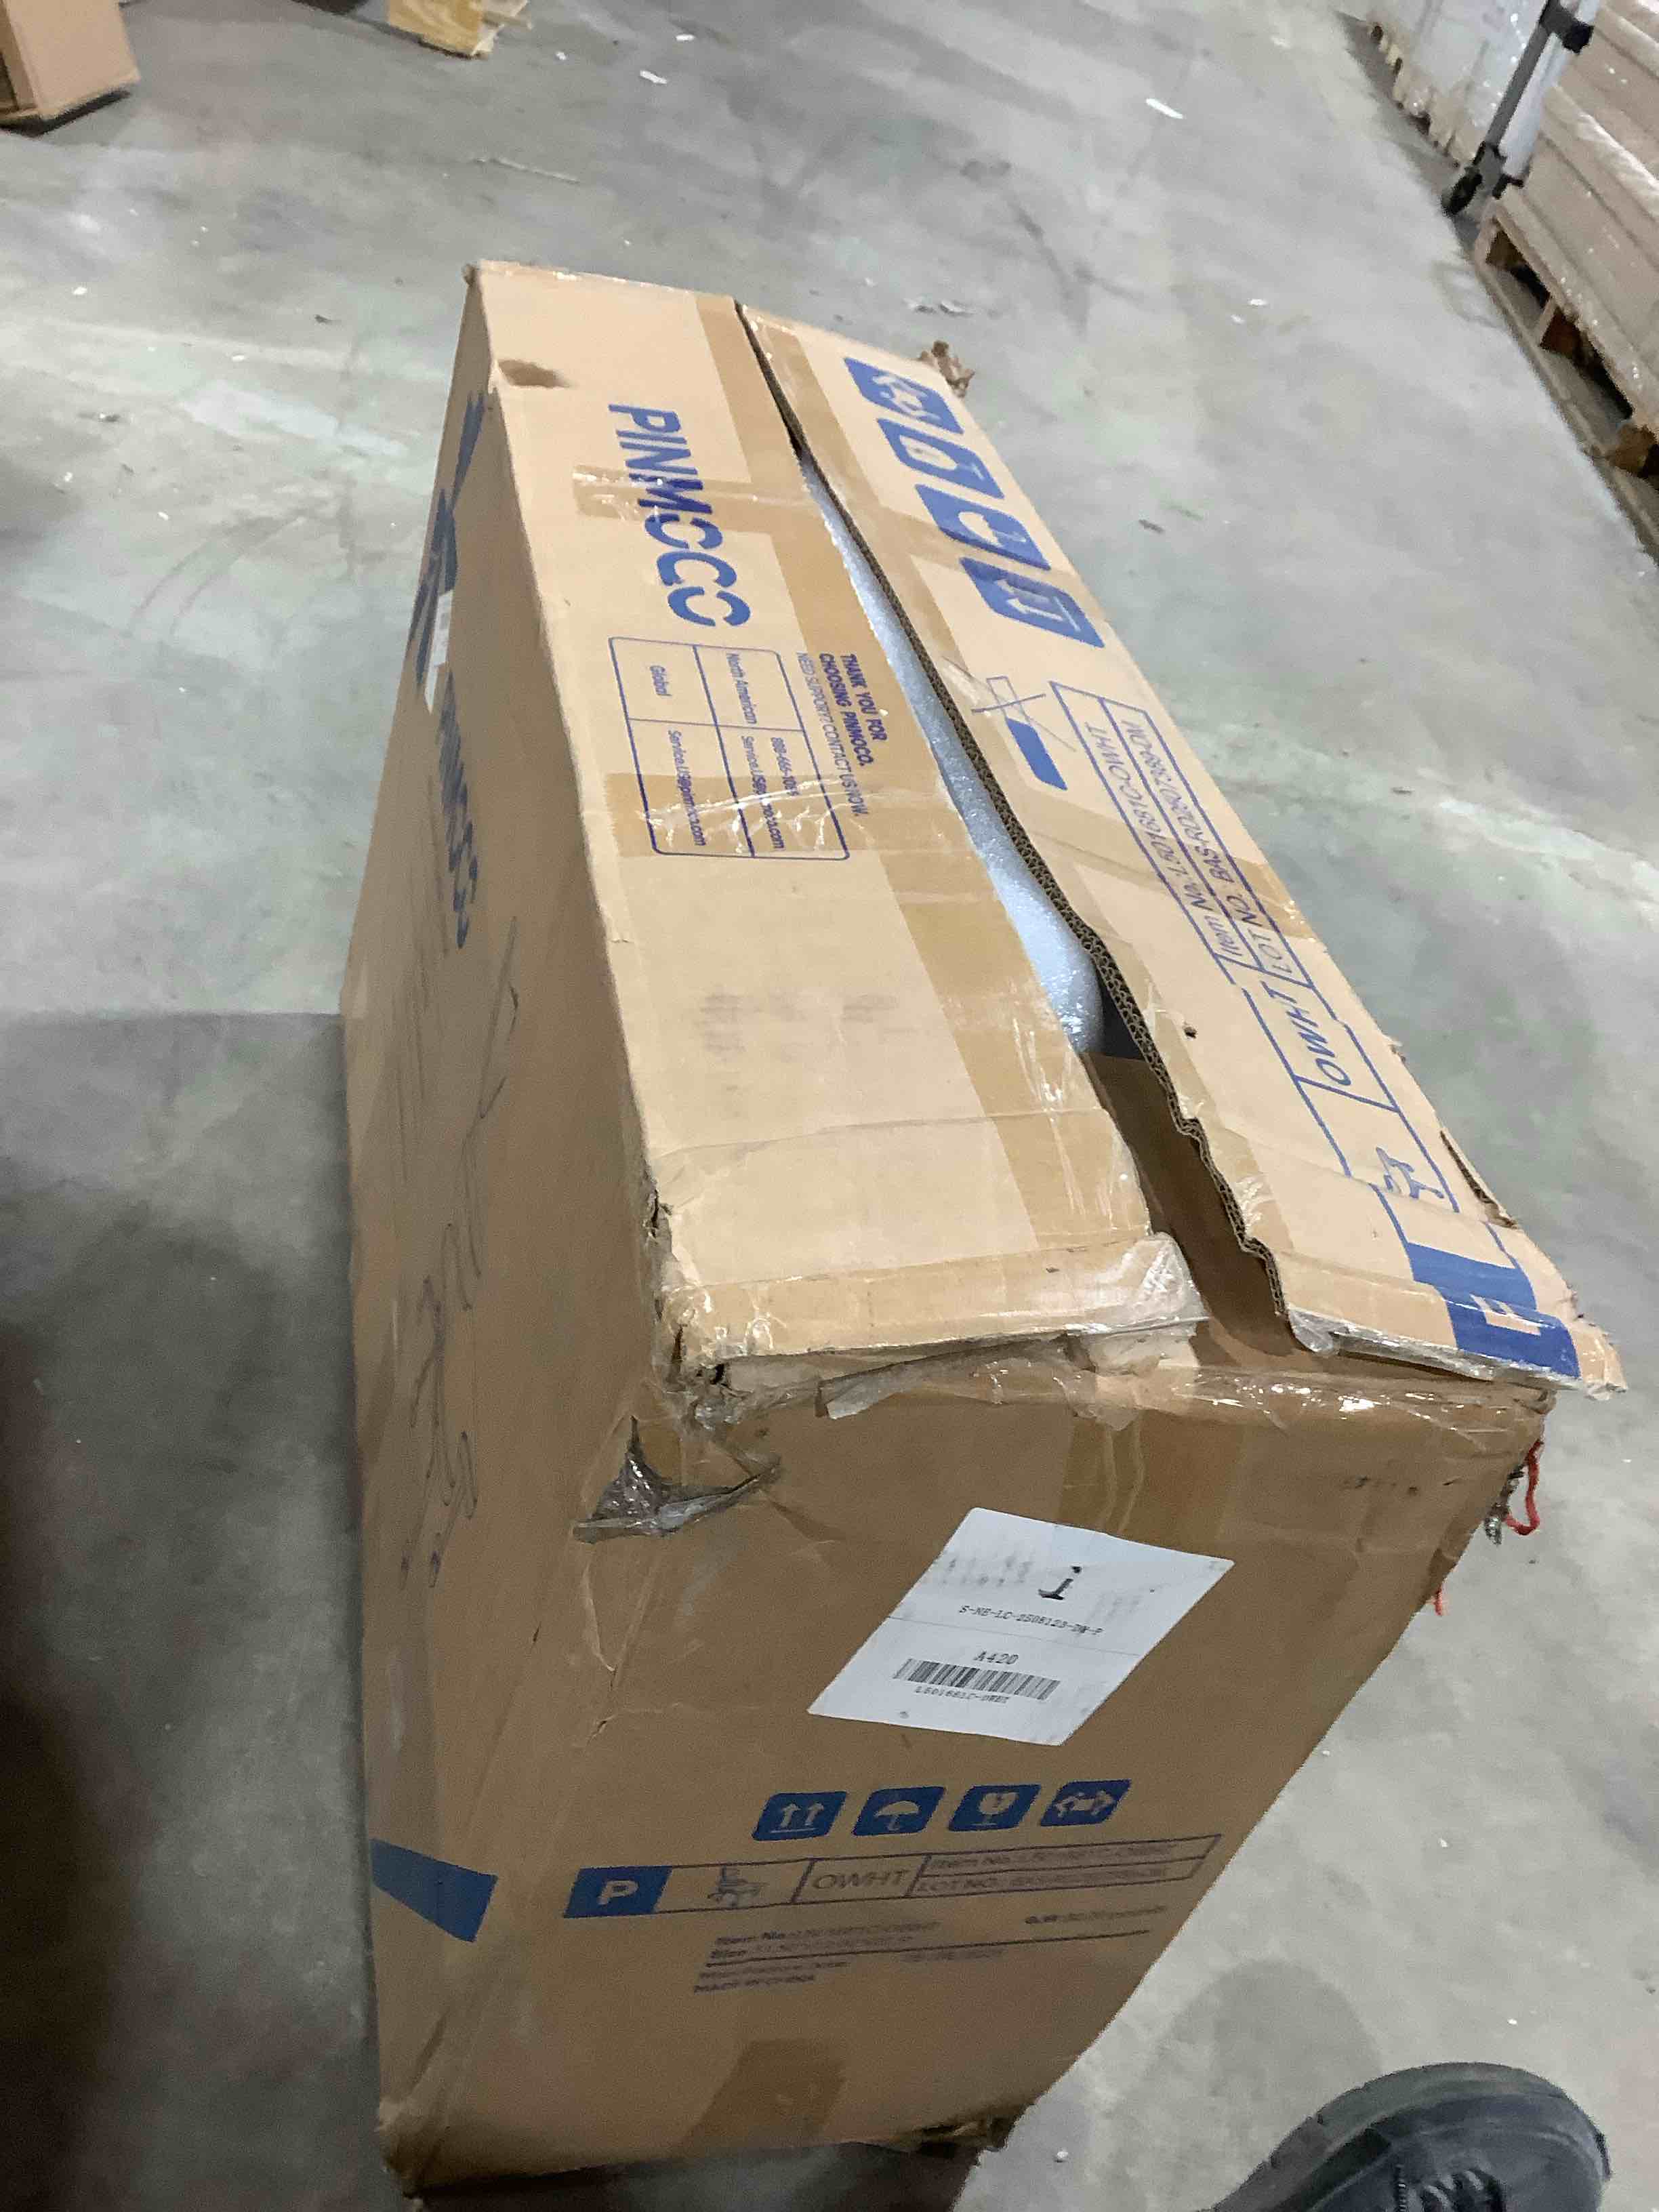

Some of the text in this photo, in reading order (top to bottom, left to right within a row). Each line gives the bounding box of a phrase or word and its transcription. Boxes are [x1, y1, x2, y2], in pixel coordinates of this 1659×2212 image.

[650, 665, 672, 696] Global
[726, 653, 757, 724] North American
[819, 653, 874, 766] CHOOSING PINMOCO.
[840, 654, 887, 741] THANK YOU FOR
[797, 653, 815, 676] NEED
[823, 724, 852, 772] CONTACT
[839, 773, 857, 788] US
[1247, 928, 1292, 973] LOT
[1260, 981, 1351, 1086] OWHT
[974, 1650, 1019, 1664] A420
[597, 1881, 638, 1906] P
[813, 1869, 912, 1891] OWHT
